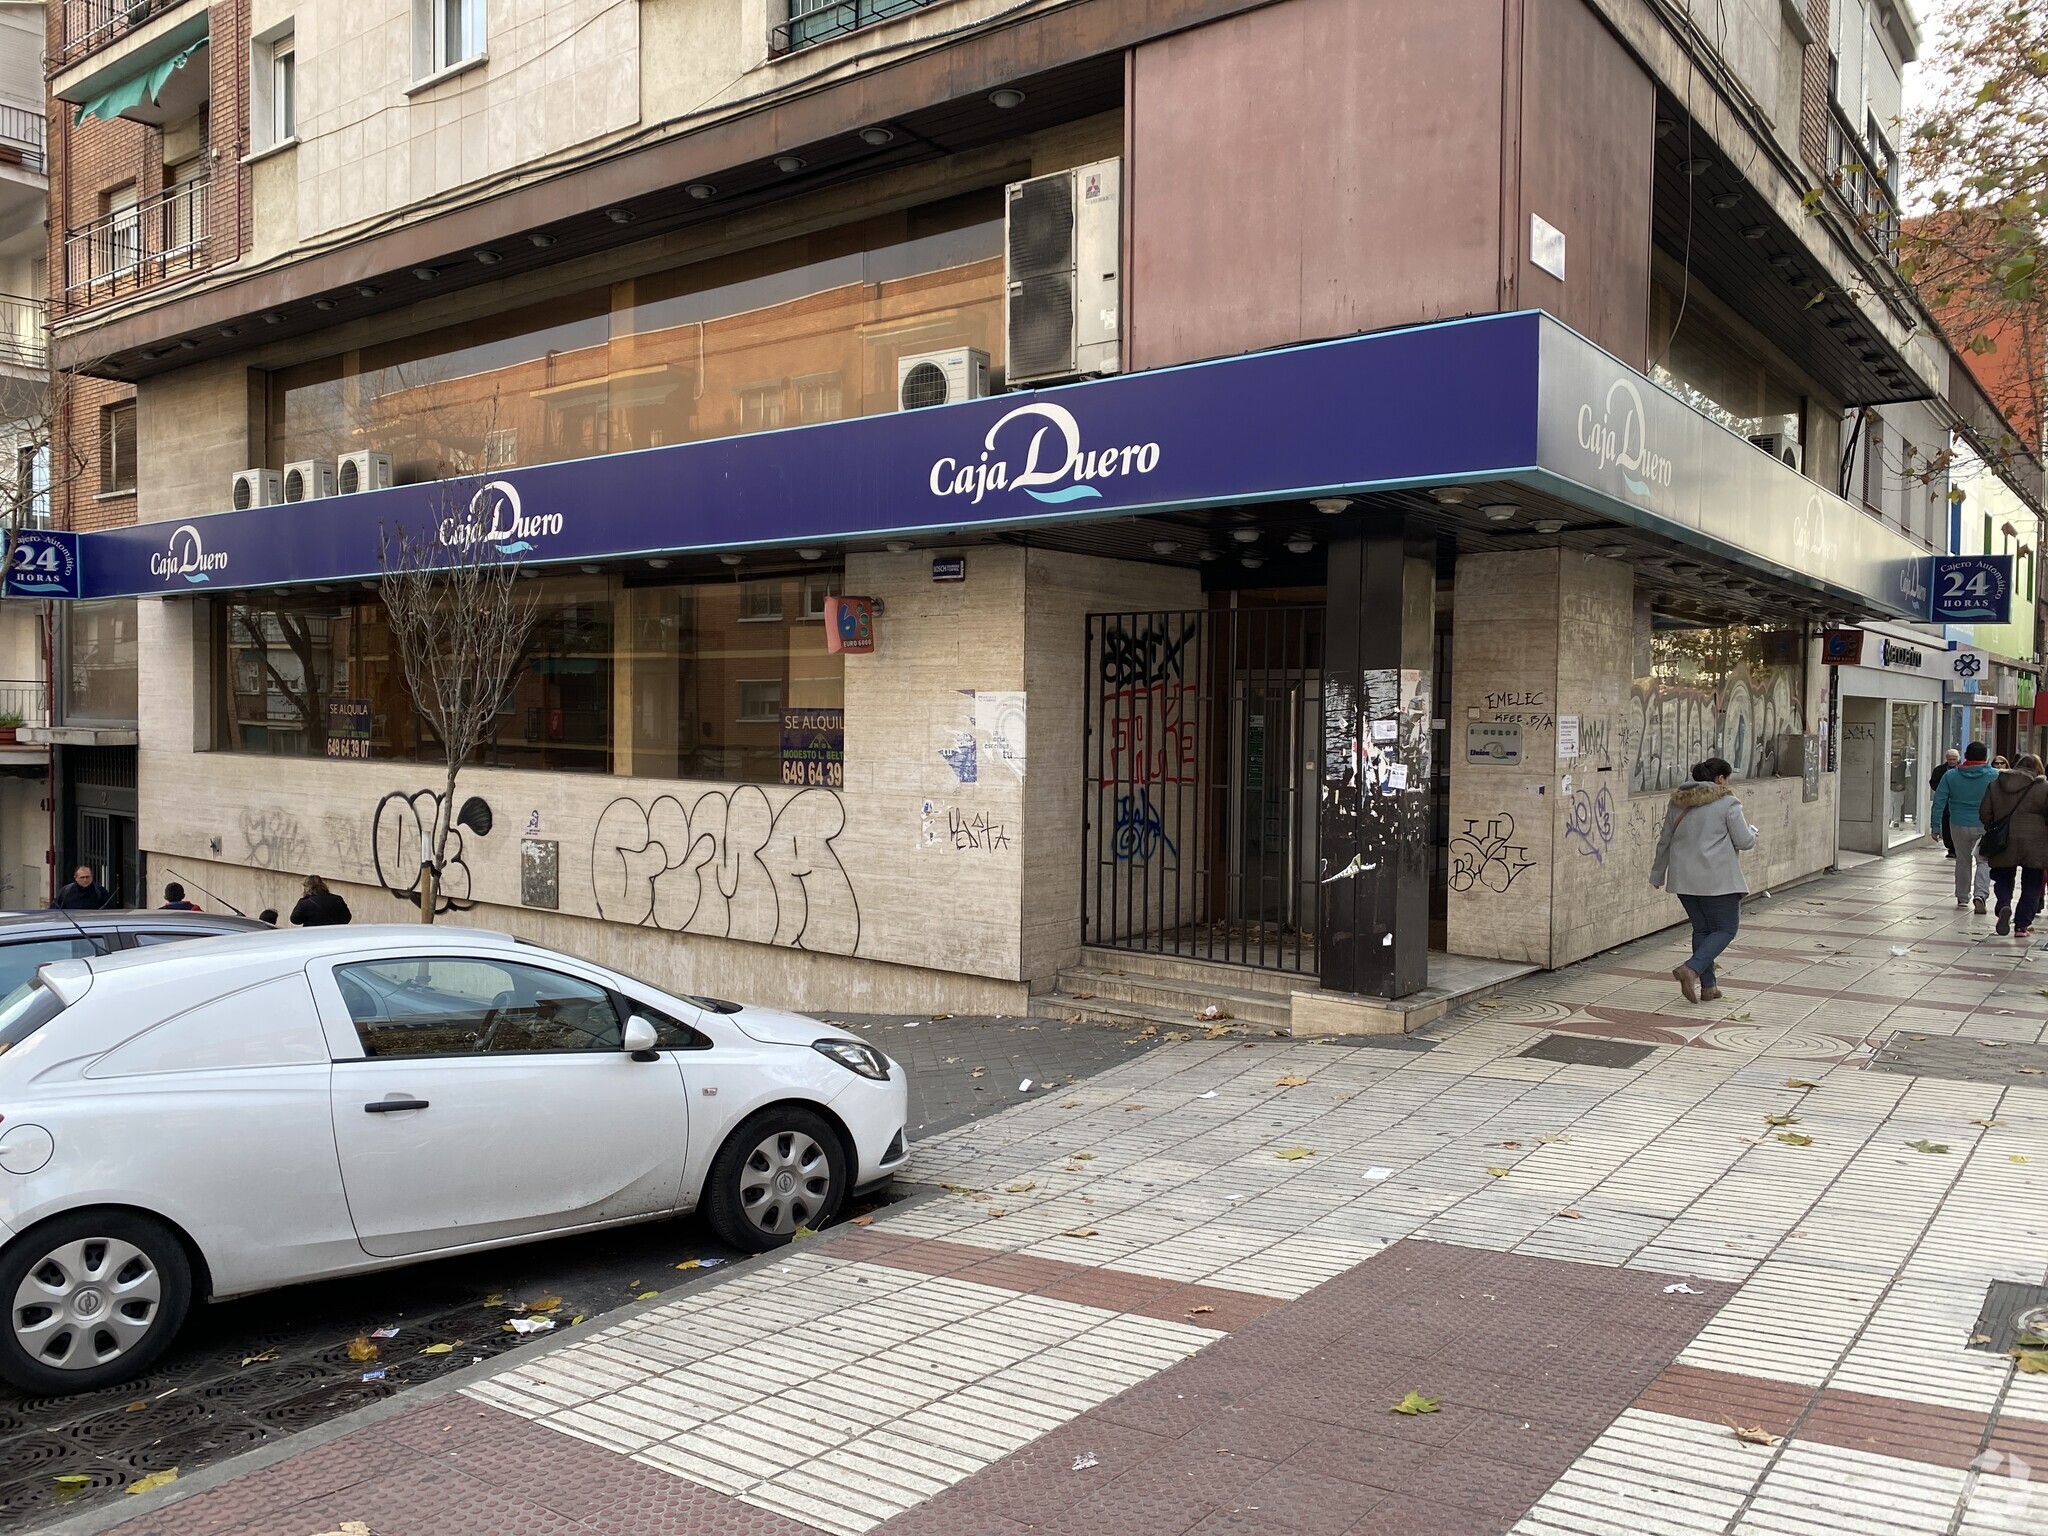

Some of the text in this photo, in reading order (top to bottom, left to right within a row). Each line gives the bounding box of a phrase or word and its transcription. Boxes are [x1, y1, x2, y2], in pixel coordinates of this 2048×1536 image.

[1577, 378, 1672, 487] Caja Duero
[929, 402, 1161, 505] Caja Duero
[440, 480, 563, 553] Caja Duero
[14, 545, 61, 572] 24
[16, 535, 74, 577] ajero Automático
[150, 524, 228, 581] Caja Duero
[16, 573, 60, 582] HORAS
[1940, 560, 2006, 600] Cajero Automático
[1942, 570, 1992, 597] 24
[1943, 599, 1989, 608] HORAS
[843, 639, 872, 648] EURO 6000
[329, 703, 369, 717] SE ALQUILA
[1485, 691, 1543, 709] EMELEC
[785, 715, 845, 732] SE ALQUIL
[1470, 728, 1518, 737] SGUROS
[327, 737, 370, 758] 649 64 39 07
[783, 749, 844, 760] MODESTO L. BELT
[782, 760, 843, 786] 649 64 39
[101, 791, 108, 806] 2
